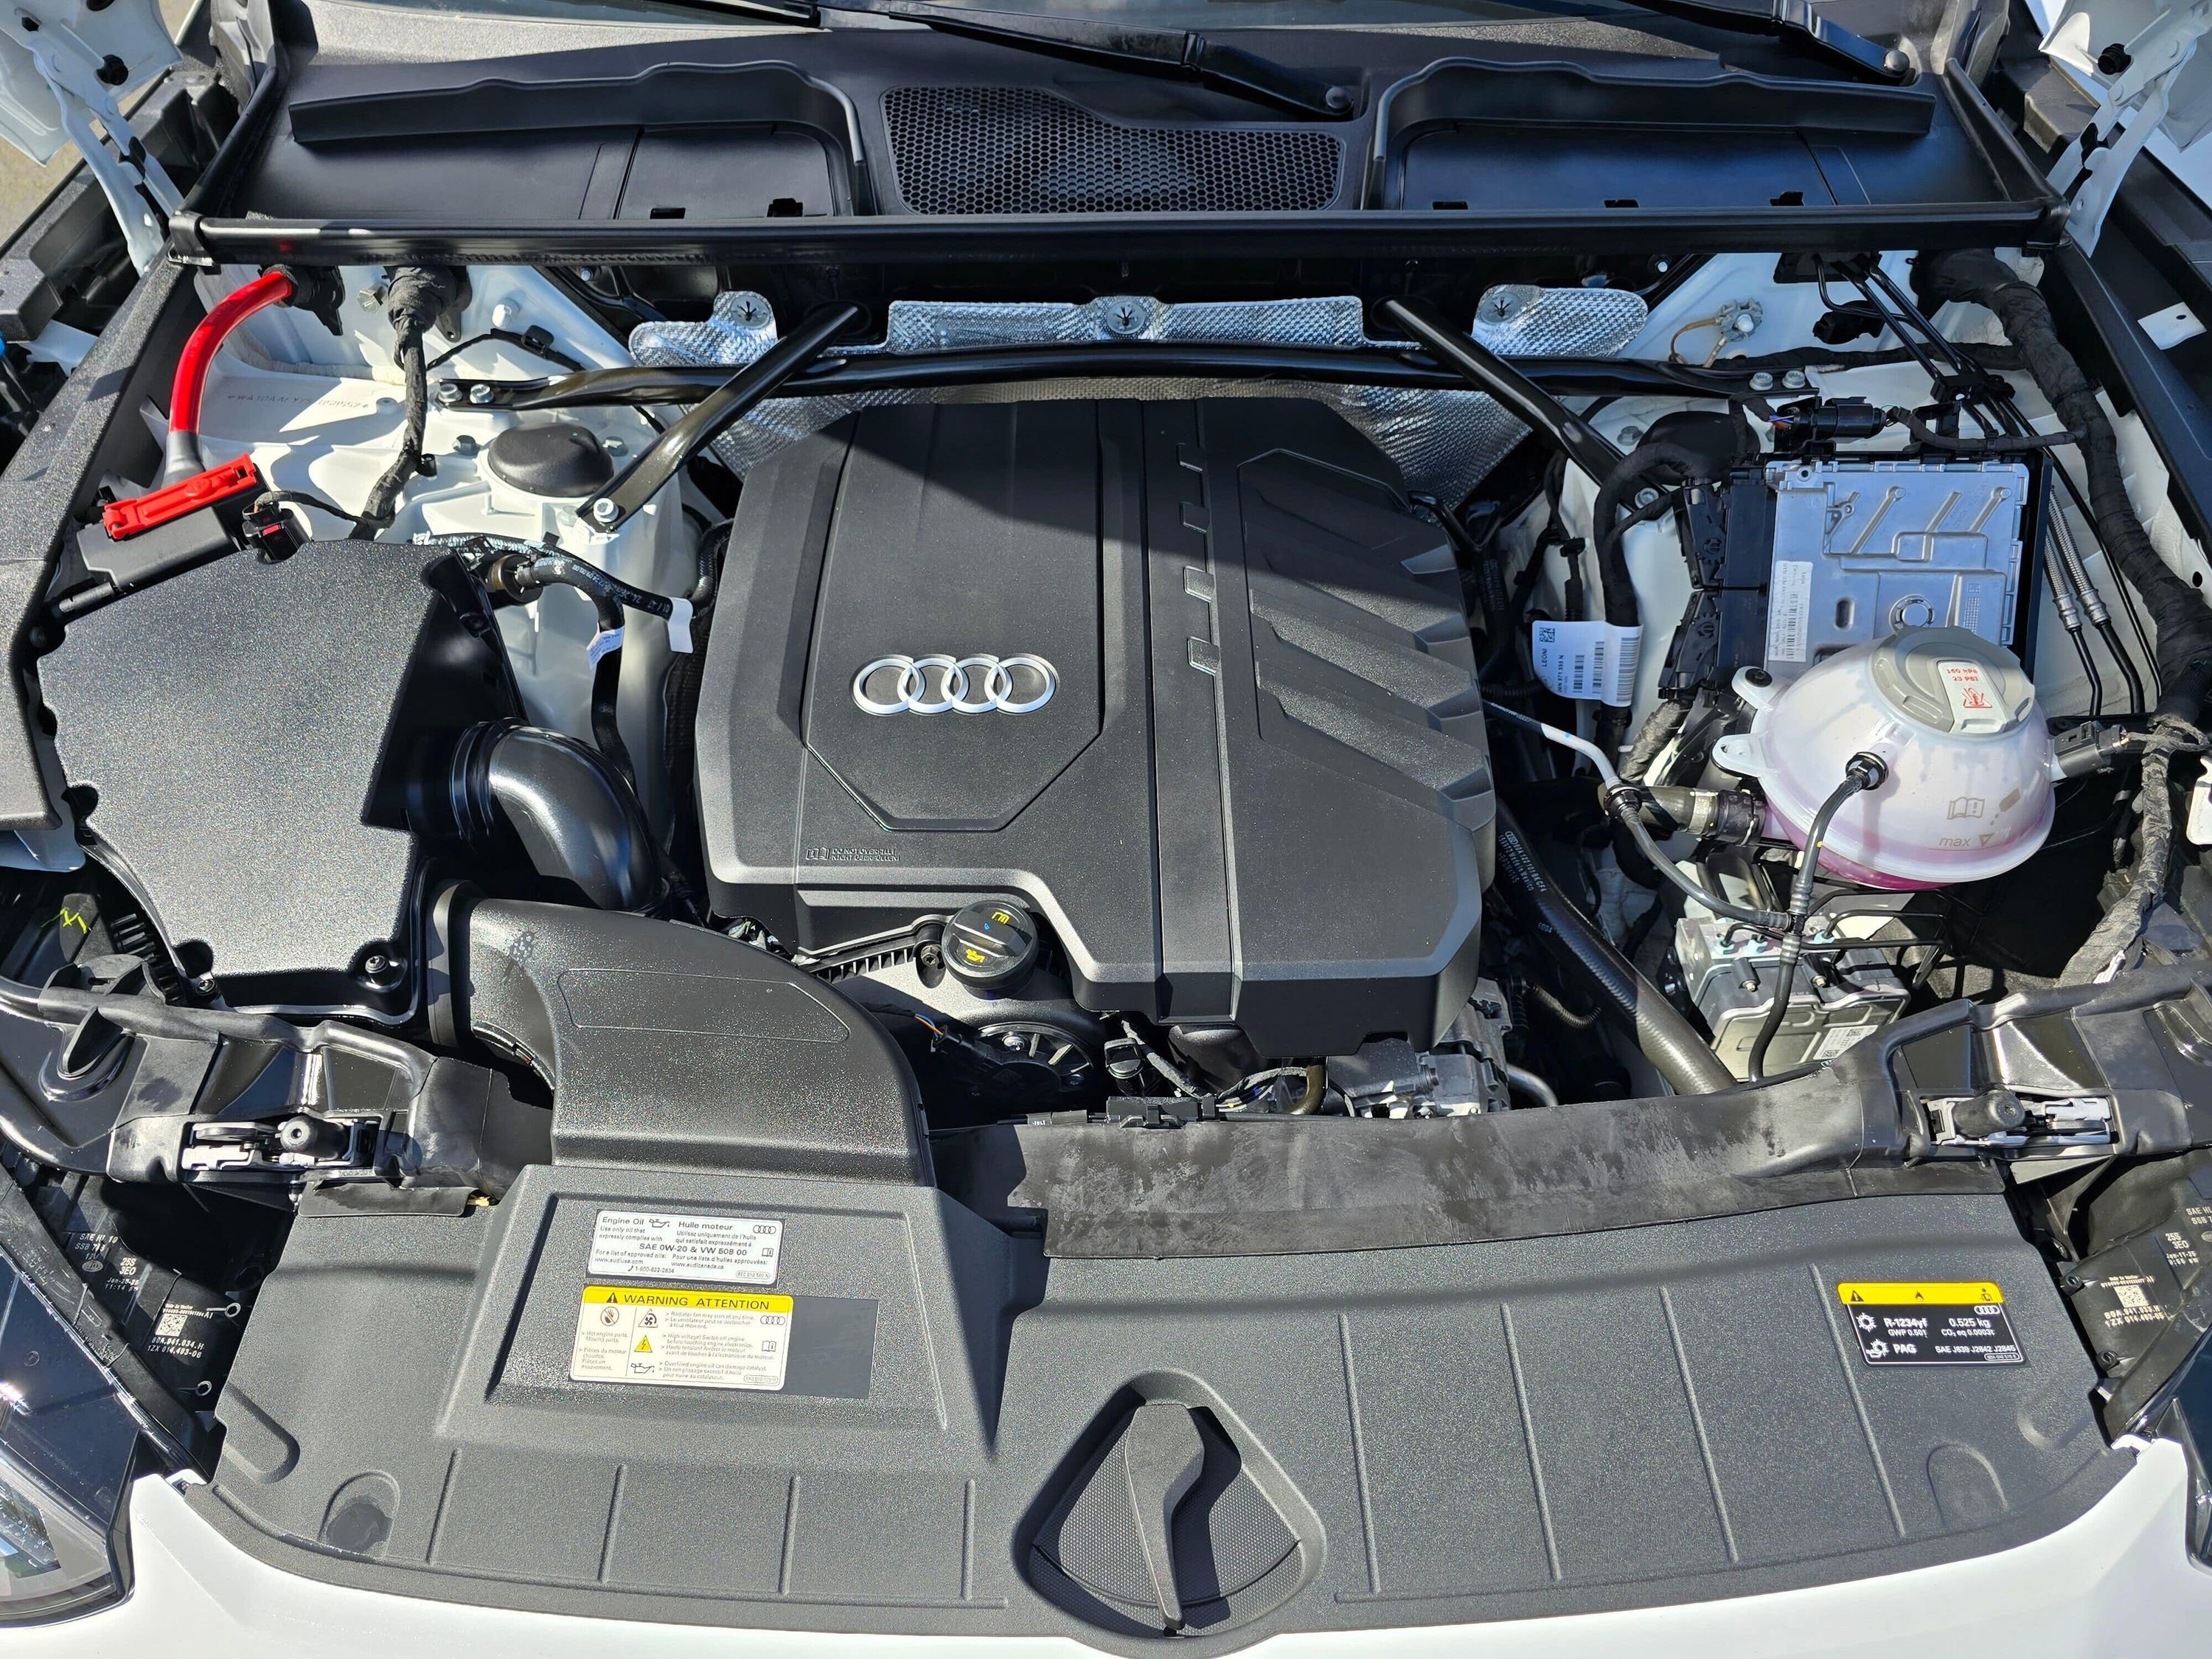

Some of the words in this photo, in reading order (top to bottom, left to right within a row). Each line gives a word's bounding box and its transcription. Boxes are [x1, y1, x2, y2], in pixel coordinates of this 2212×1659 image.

[1939, 838, 1972, 847] max
[1520, 854, 1531, 863] 122
[1520, 871, 1534, 891] Mexico
[2185, 1207, 2202, 1216] SAE
[602, 1217, 630, 1225] Engine
[2191, 1217, 2208, 1225] SSB
[80, 1233, 94, 1242] SAE
[2165, 1232, 2182, 1242] 25S
[120, 1257, 136, 1267] 25S
[671, 1262, 724, 1270] www.audicanada.ca
[624, 1294, 689, 1306] WARNING
[695, 1298, 769, 1310] ATTENTION
[1883, 1318, 1929, 1329] R-1234yf
[1948, 1318, 1976, 1327] 0.525
[1978, 1318, 1991, 1329] kg
[2104, 1316, 2124, 1328] 1ZX
[152, 1337, 204, 1350] 80A.941.034.H
[1892, 1343, 1917, 1354] PAG
[1971, 1345, 1992, 1353] J2842
[161, 1345, 202, 1358] 014.493-06
